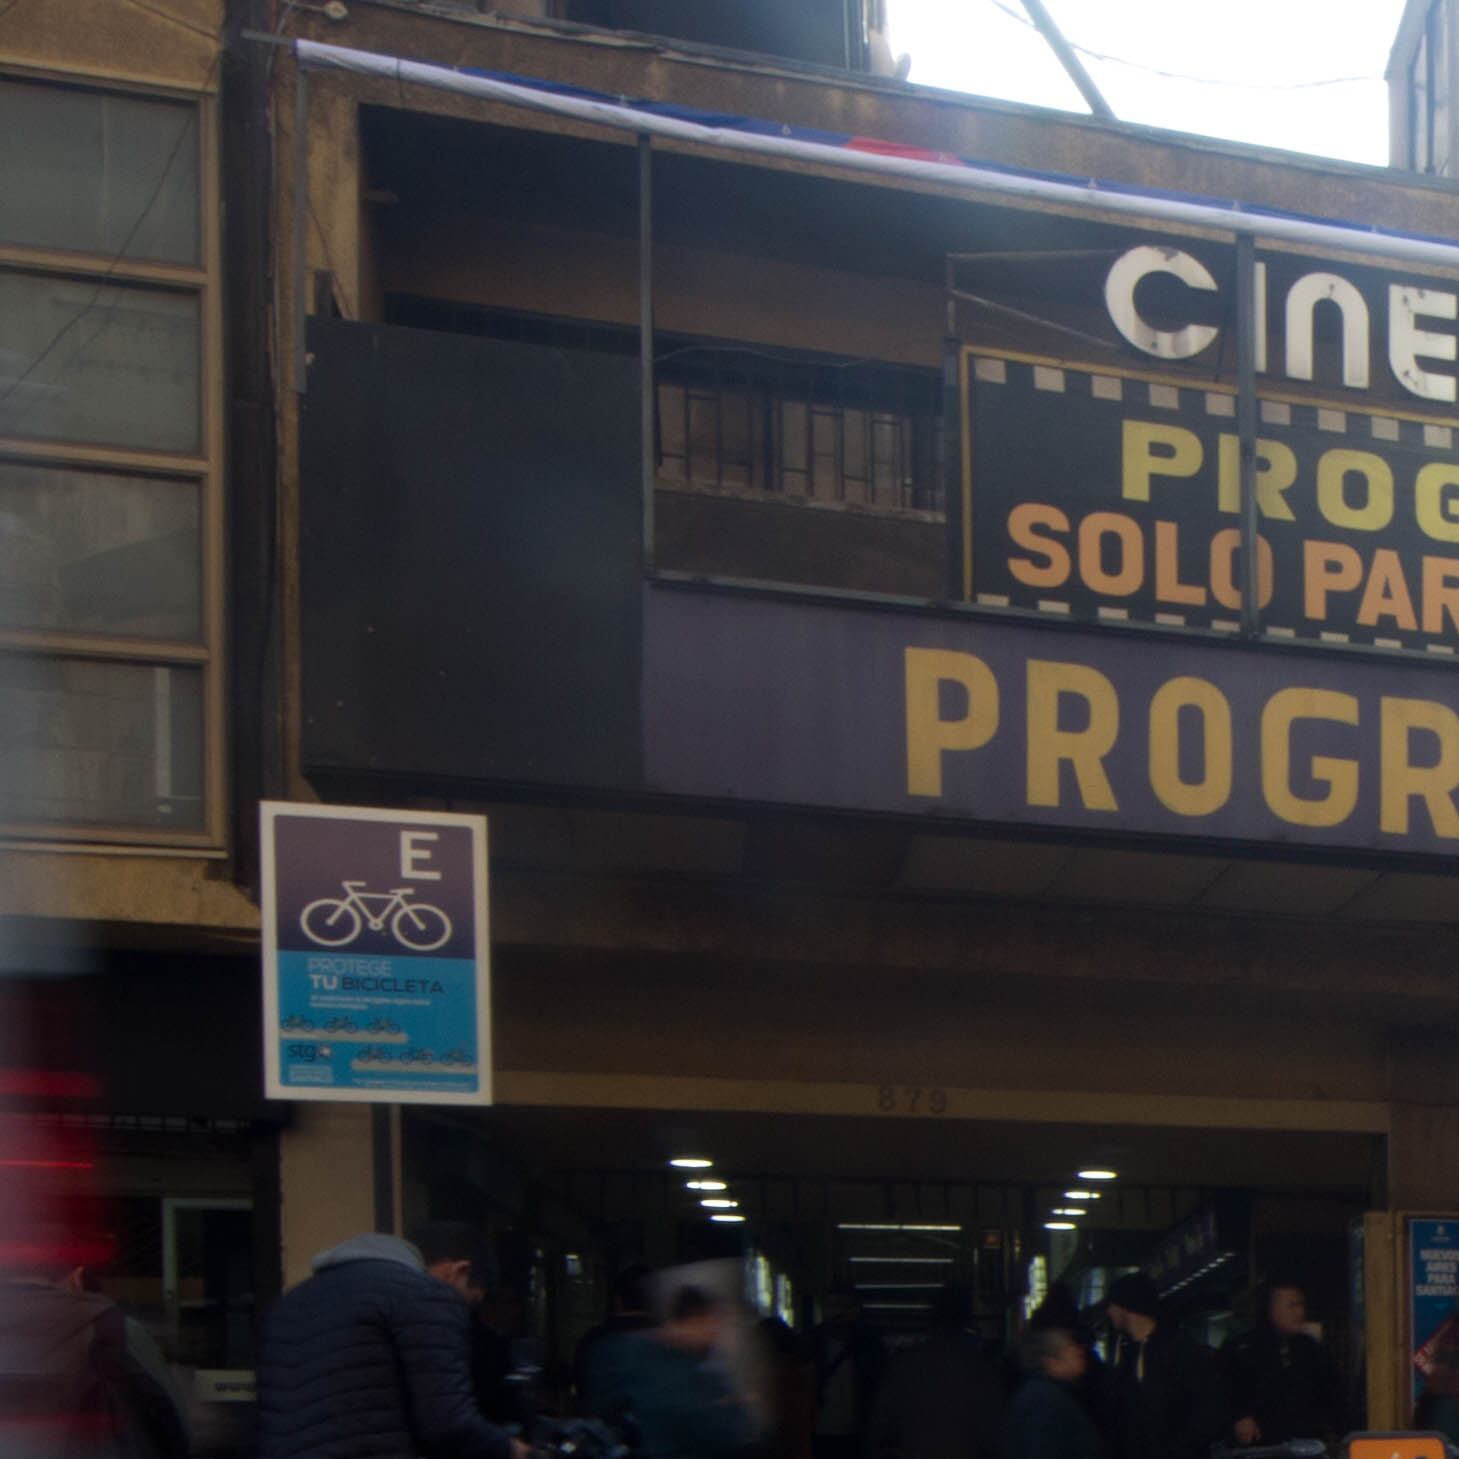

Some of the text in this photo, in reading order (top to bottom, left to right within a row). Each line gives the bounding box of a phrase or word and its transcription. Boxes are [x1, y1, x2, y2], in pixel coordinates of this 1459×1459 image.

[1104, 245, 1458, 402] CINE
[1007, 502, 1273, 611] SOLO
[401, 831, 441, 881] E
[308, 957, 392, 976] PROTEGE
[310, 973, 447, 995] TU BICICLETA
